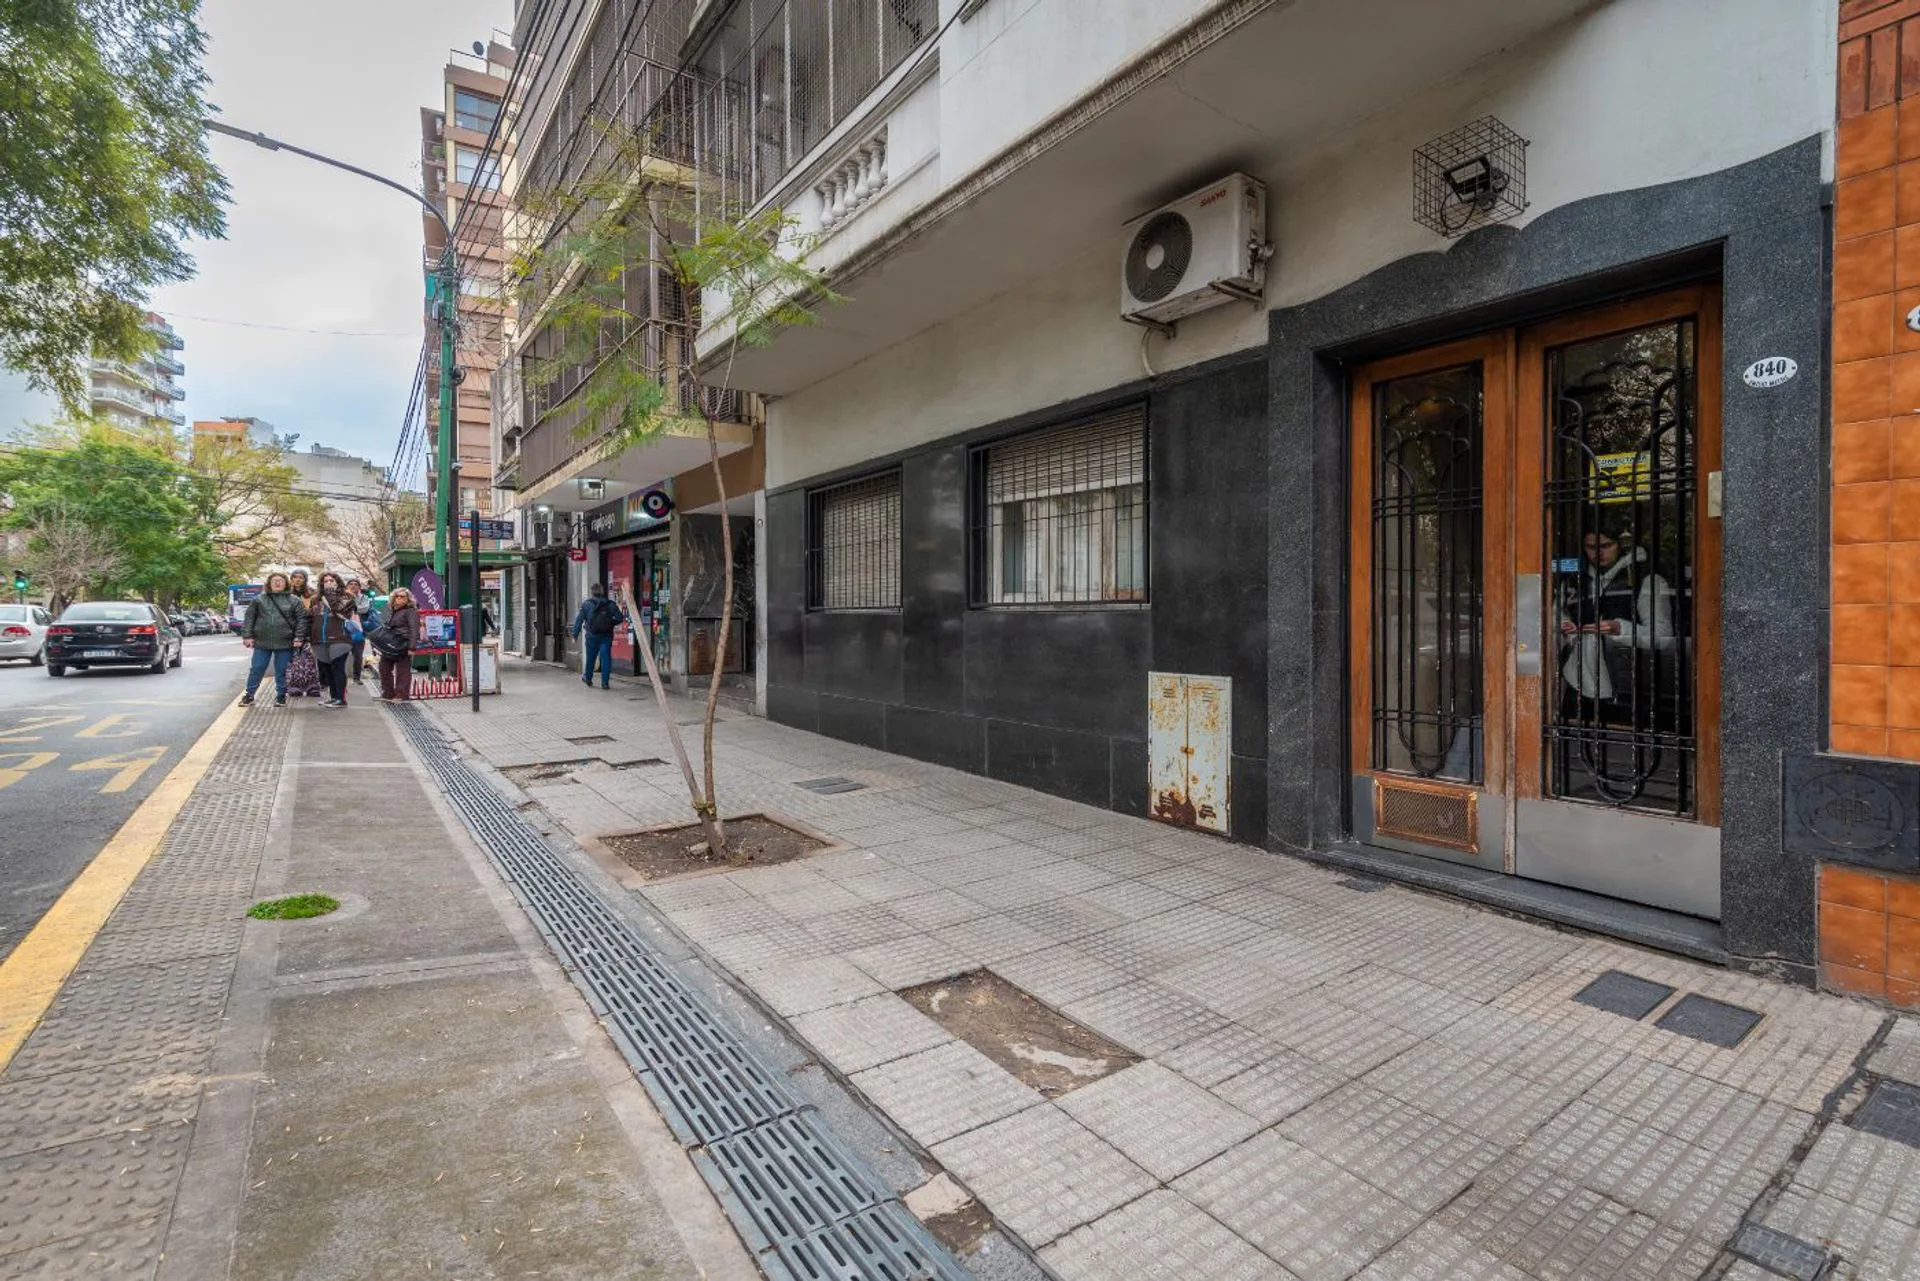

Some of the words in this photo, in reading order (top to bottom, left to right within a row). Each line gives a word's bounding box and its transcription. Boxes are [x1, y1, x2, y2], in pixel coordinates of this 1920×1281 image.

[1199, 188, 1227, 208] SANYO
[1753, 358, 1788, 378] 840
[590, 512, 616, 534] rapipago
